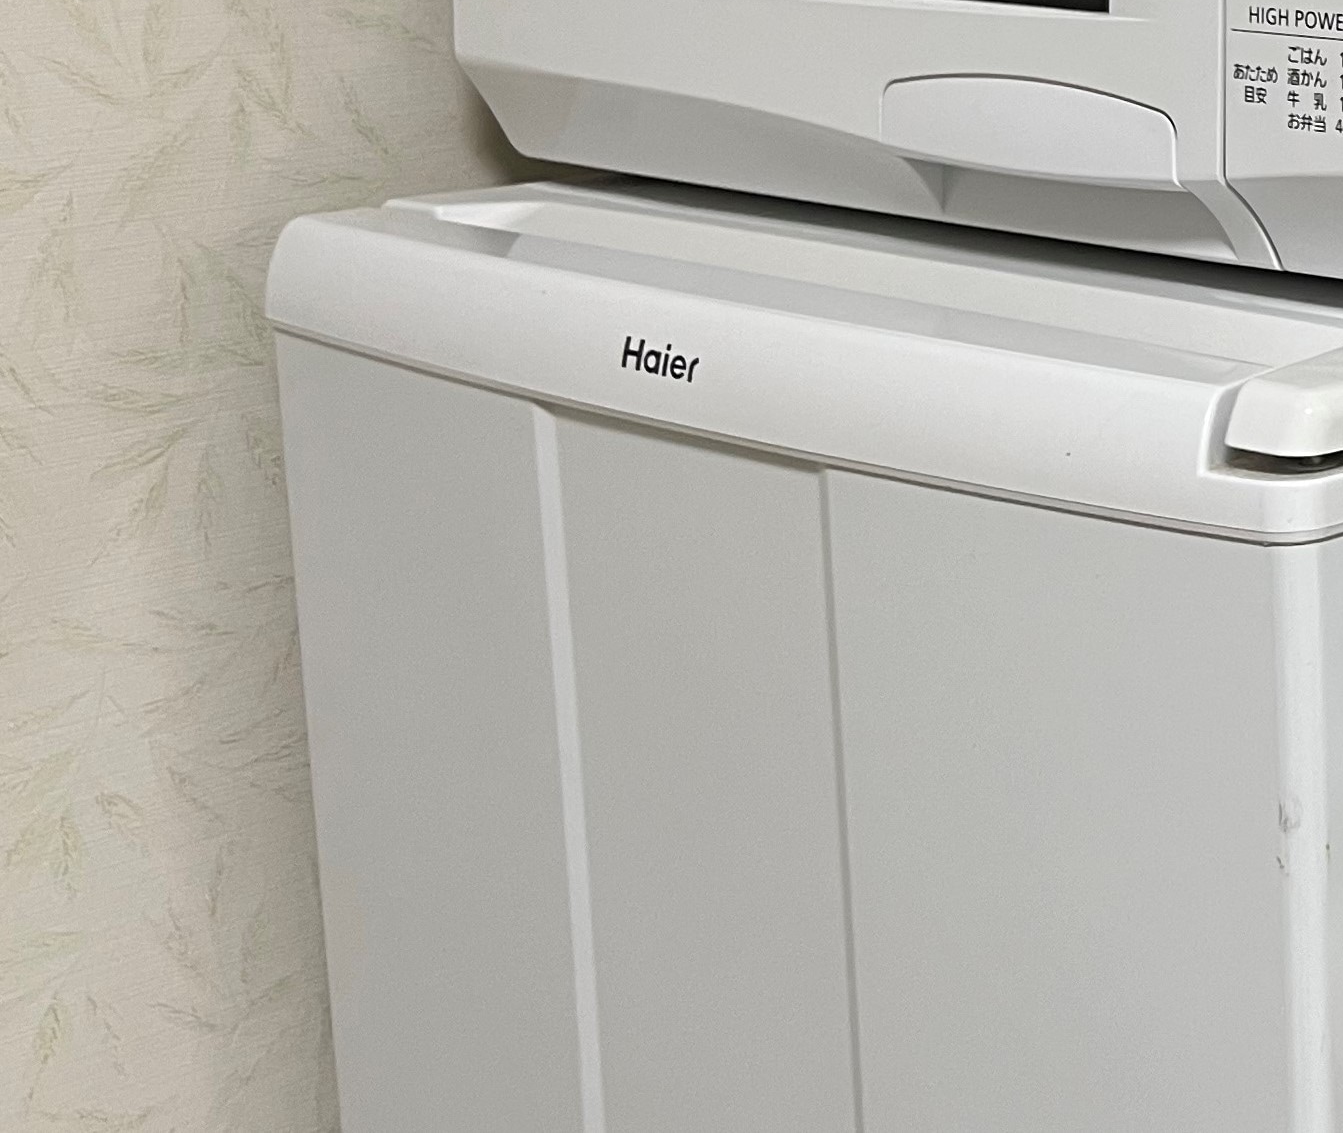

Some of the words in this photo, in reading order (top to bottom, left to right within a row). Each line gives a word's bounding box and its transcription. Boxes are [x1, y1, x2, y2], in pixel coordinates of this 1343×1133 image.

[1248, 6, 1289, 27] HIGH
[1288, 46, 1327, 66] ごはん
[1233, 64, 1278, 83] あたため
[1287, 68, 1327, 88] 酒かん
[1244, 85, 1267, 105] 目安
[1288, 113, 1327, 133] お弁当
[621, 335, 700, 383] Haier
